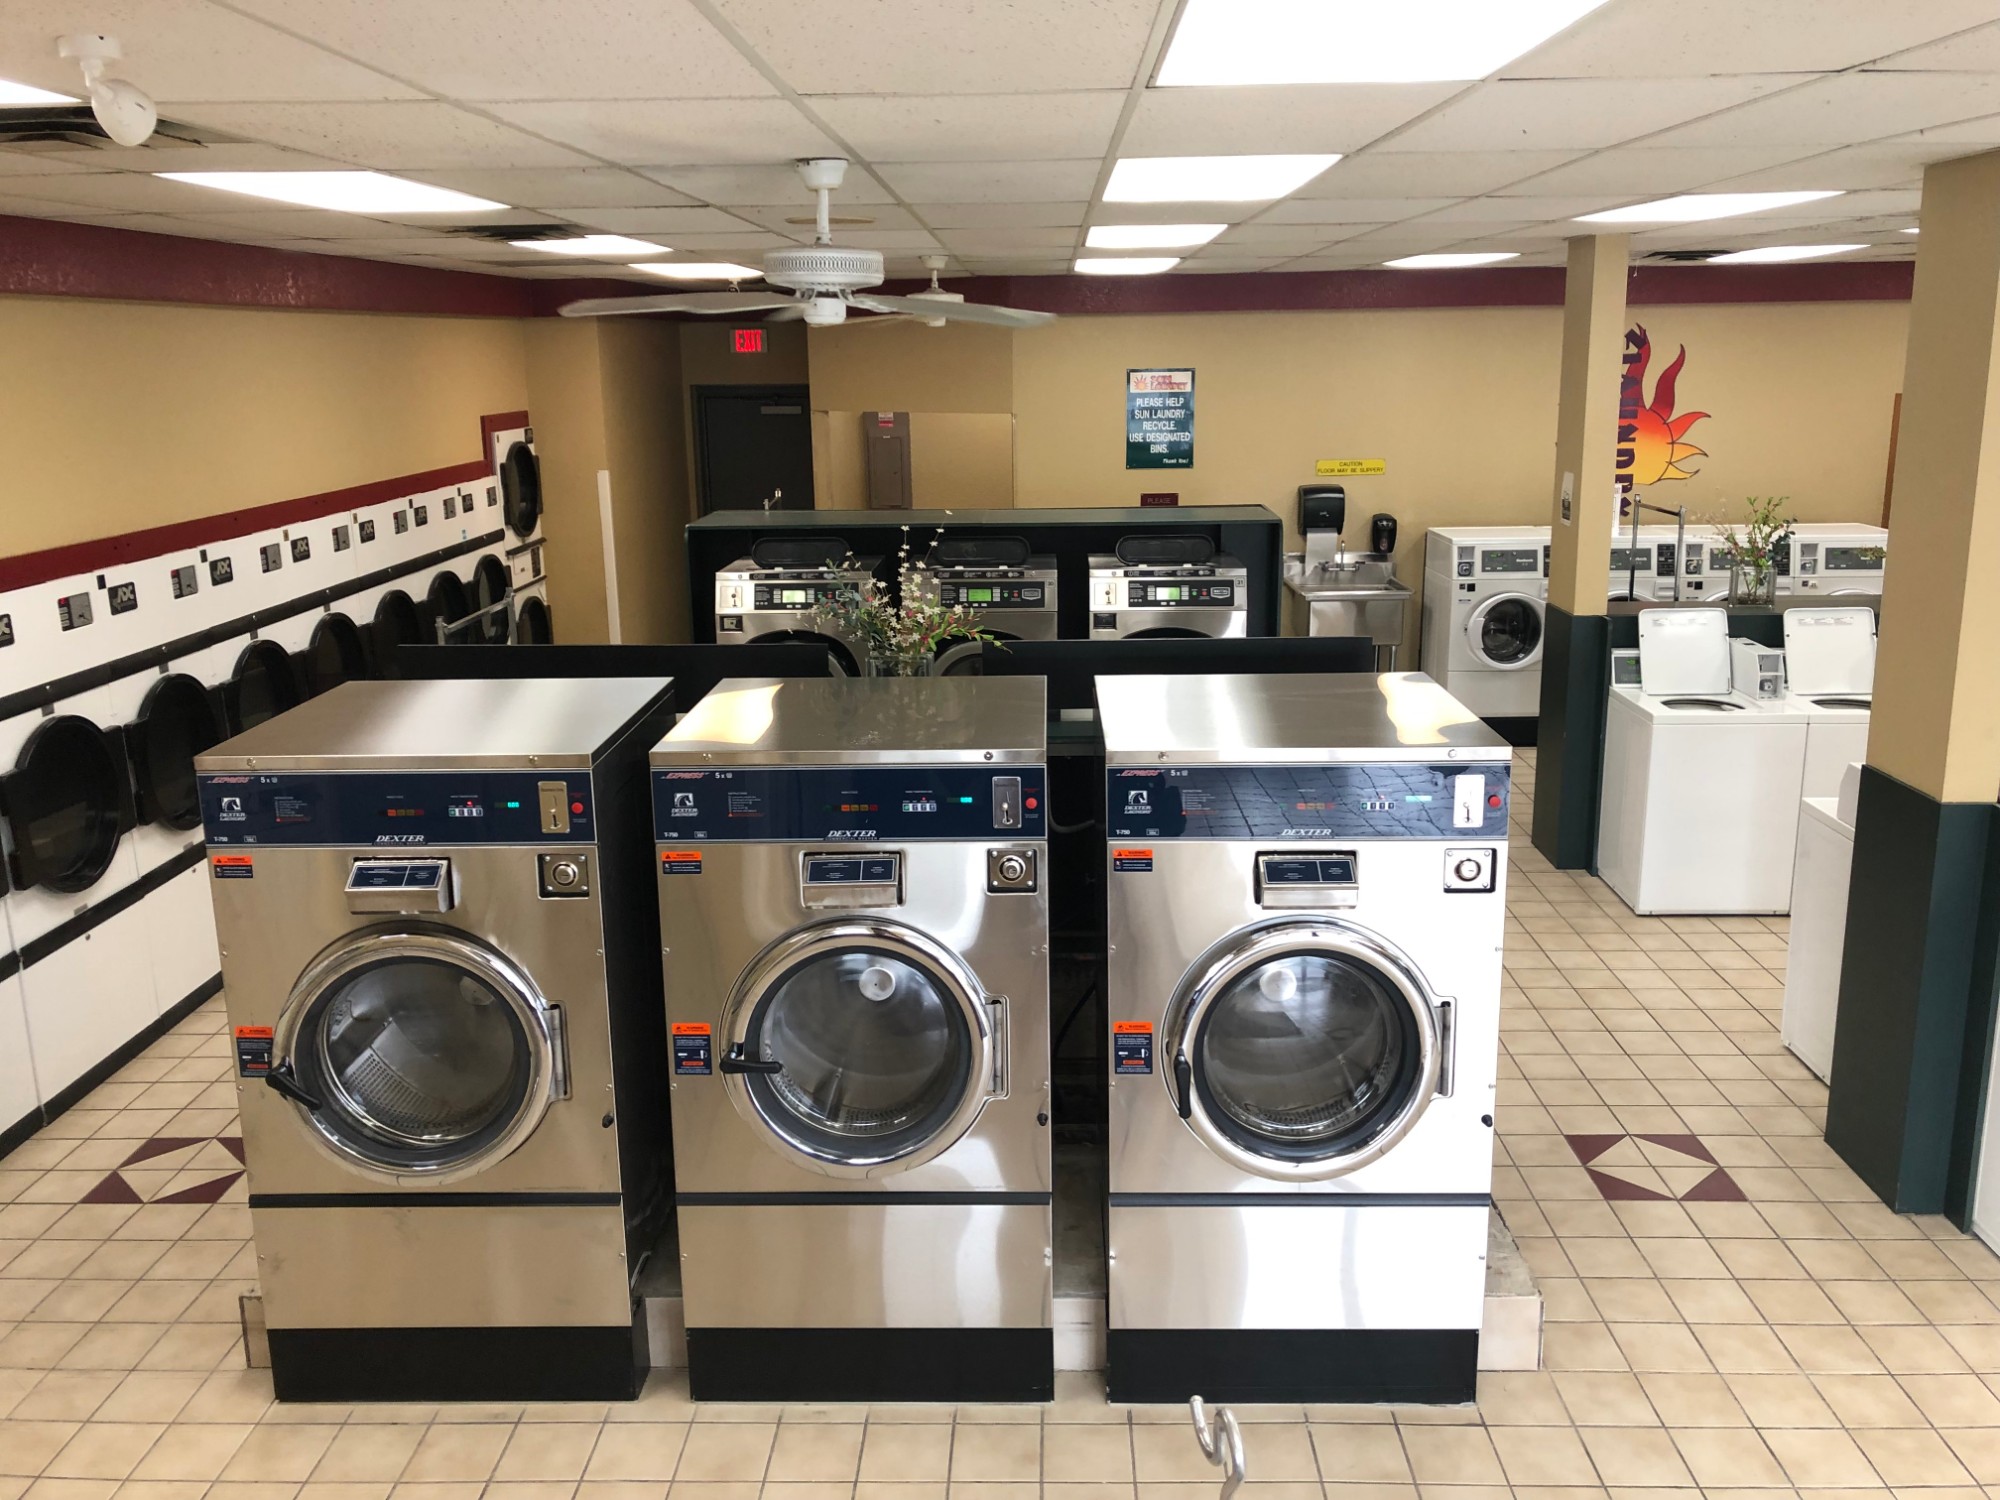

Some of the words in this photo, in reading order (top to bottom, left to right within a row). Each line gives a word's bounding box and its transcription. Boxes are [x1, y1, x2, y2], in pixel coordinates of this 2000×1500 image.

[735, 329, 762, 352] EXIT
[1136, 398, 1163, 407] PLEASE
[1165, 397, 1184, 406] HELP
[1134, 410, 1150, 419] SUN
[1152, 409, 1185, 419] LAUNDRY
[1142, 421, 1177, 430] RECYCLE.
[1129, 433, 1144, 442] USE
[1146, 432, 1191, 442] DESIGNATED
[1150, 444, 1169, 453] BINS.
[827, 829, 876, 837] DEXTER
[1281, 828, 1332, 836] DEXTER
[376, 834, 425, 842] DEXTER
